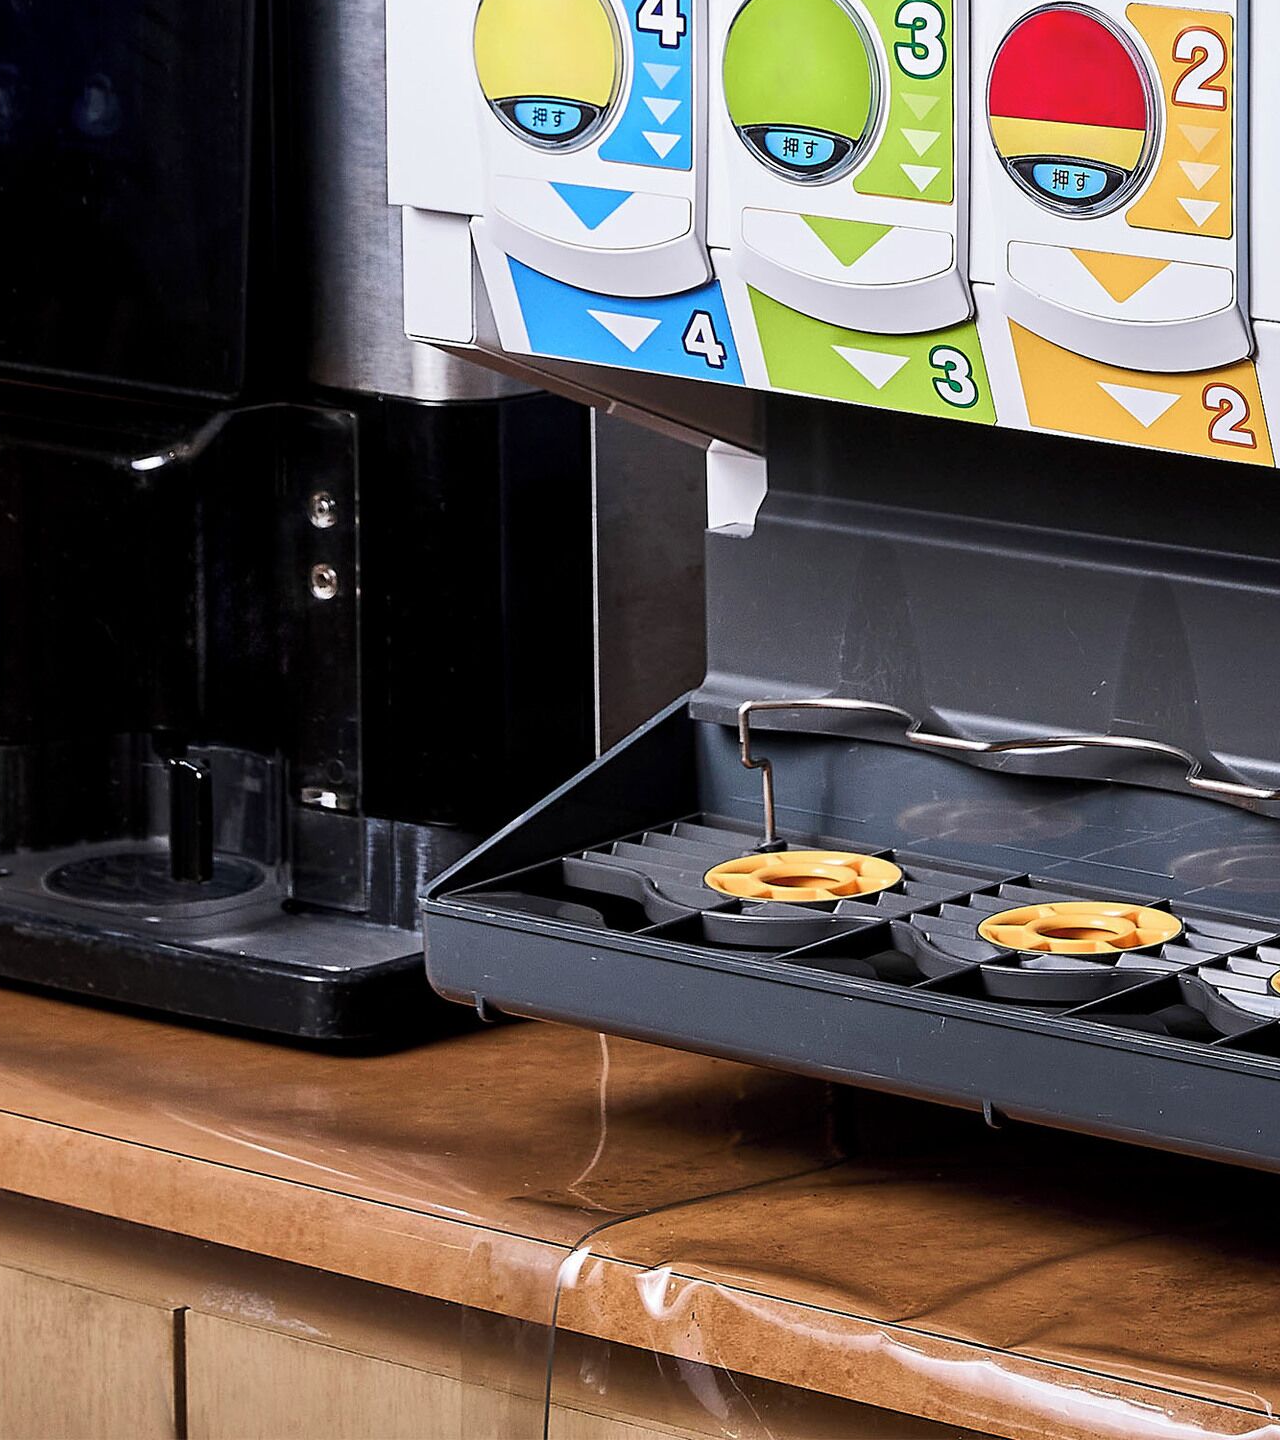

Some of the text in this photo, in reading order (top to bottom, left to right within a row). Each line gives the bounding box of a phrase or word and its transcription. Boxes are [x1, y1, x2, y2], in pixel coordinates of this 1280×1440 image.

[1171, 24, 1227, 112] 2
[531, 105, 565, 129] 押す
[781, 135, 819, 159] 押す
[1051, 169, 1091, 192] 押す
[682, 310, 727, 369] 4
[927, 344, 978, 409] 3
[1201, 381, 1257, 450] 2
